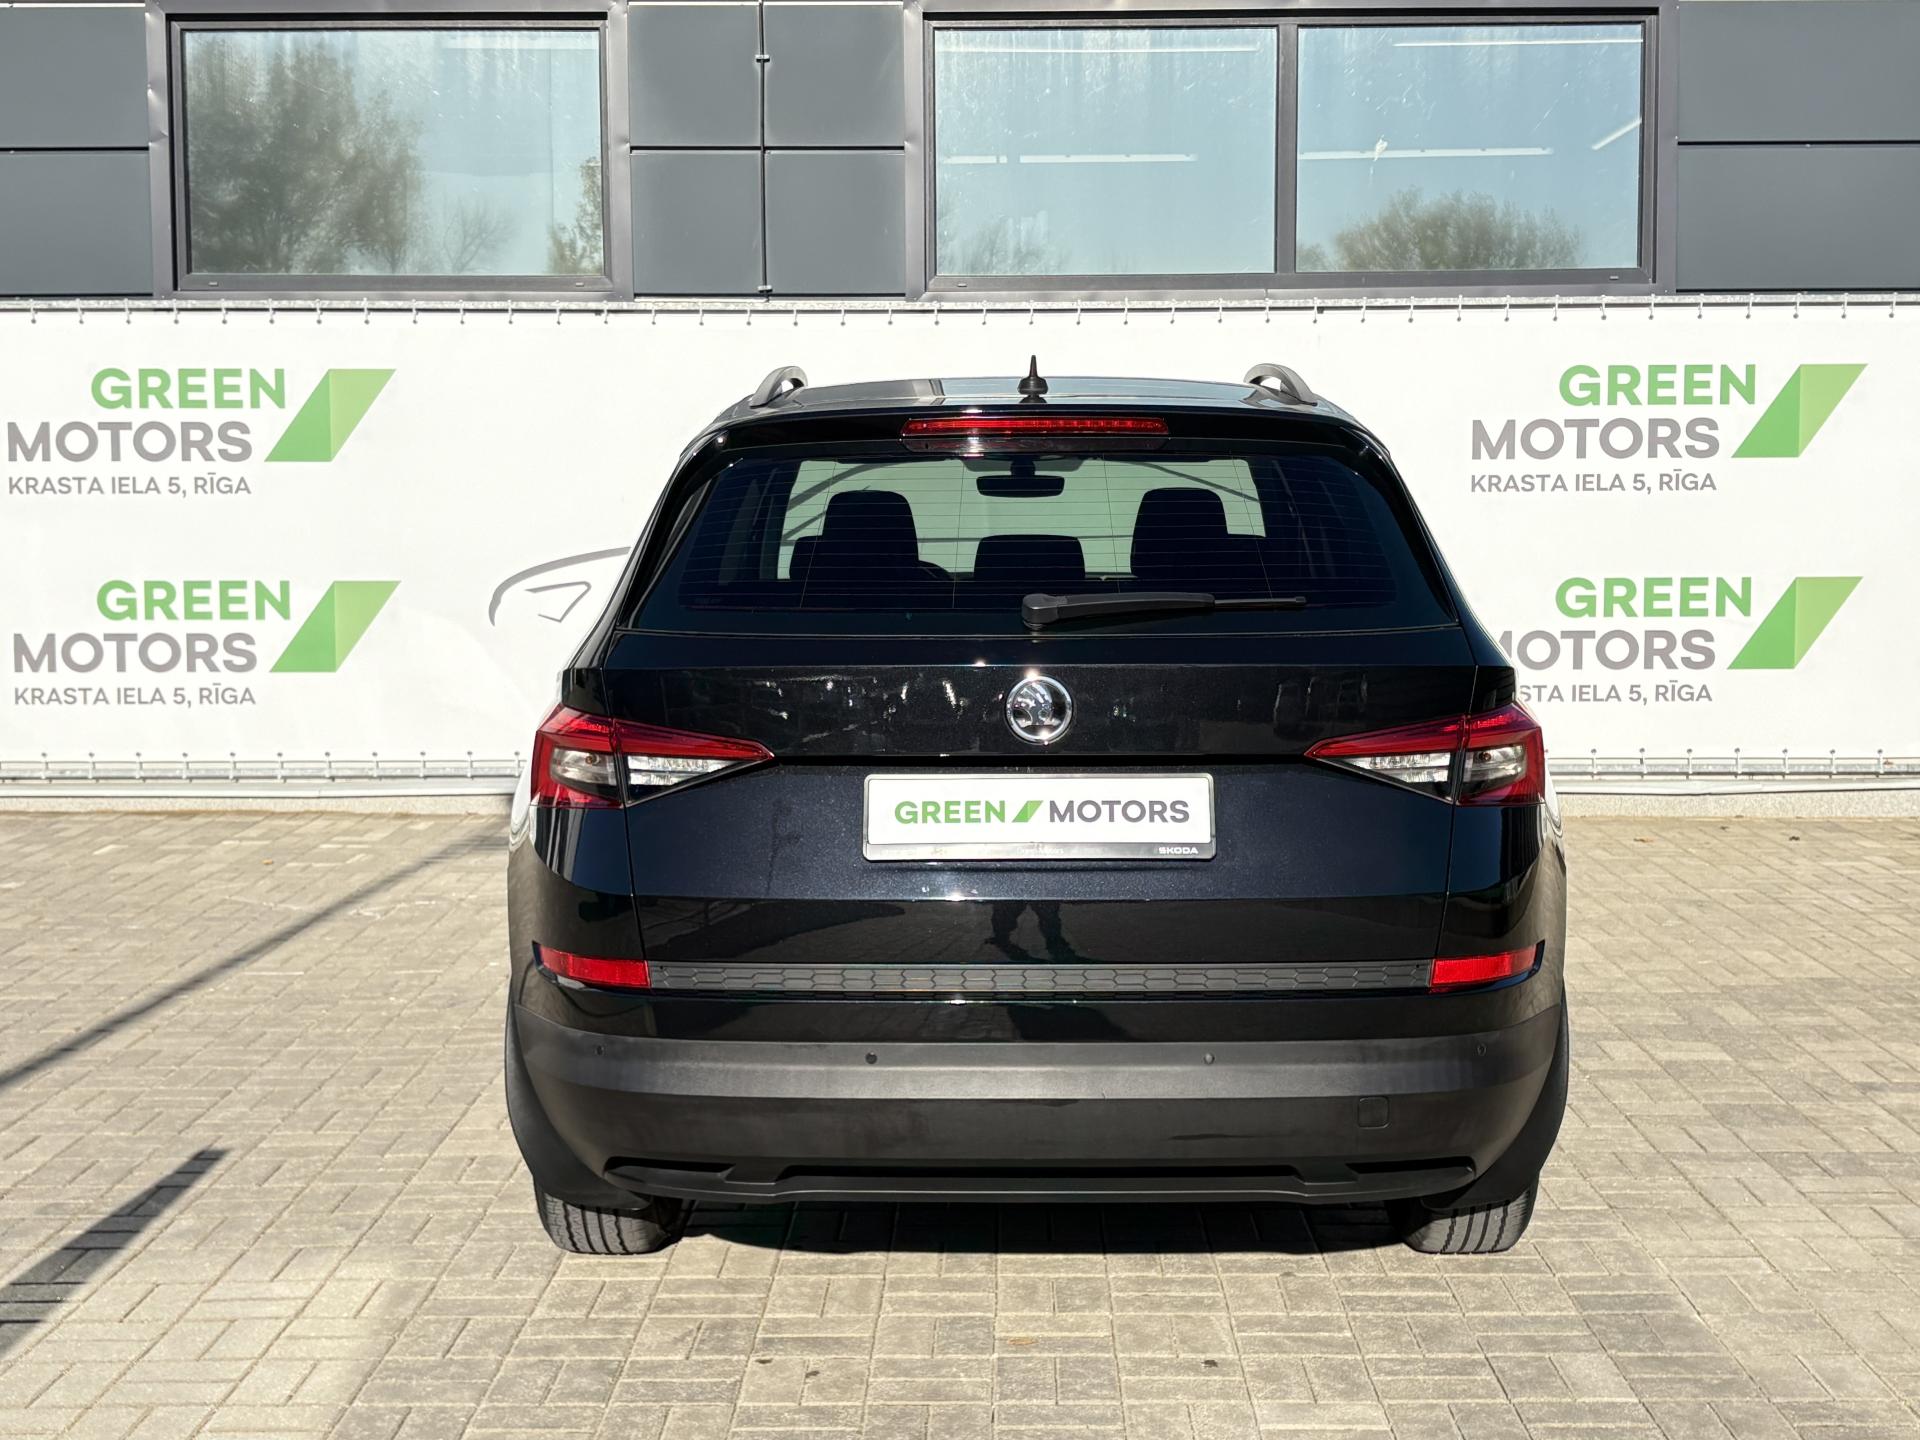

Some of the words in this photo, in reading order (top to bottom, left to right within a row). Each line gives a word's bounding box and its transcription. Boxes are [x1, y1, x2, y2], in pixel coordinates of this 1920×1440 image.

[91, 368, 286, 409] GREEN
[1559, 364, 1756, 406] GREEN
[7, 421, 253, 462] MOTORS
[1472, 417, 1720, 460] MOTORS
[8, 477, 105, 494] KRASTA
[111, 477, 161, 494] IELA
[168, 477, 187, 498] 5,
[194, 473, 252, 494] RĪGA
[1471, 474, 1568, 492] KRASTA
[1575, 474, 1625, 491] IELA
[1632, 474, 1651, 495] 5,
[1659, 469, 1717, 491] RĪGA
[97, 580, 291, 621] GREEN
[1555, 577, 1752, 618] GREEN
[13, 633, 257, 673] MOTORS
[15, 688, 109, 704] KRASTA
[117, 688, 166, 704] IELA
[173, 688, 192, 708] 5,
[199, 683, 256, 704] RĪGA
[1572, 685, 1622, 702] IELA
[1628, 685, 1648, 706] 5,
[1655, 680, 1713, 702] RĪGA
[895, 800, 1006, 824] GREEN
[1049, 800, 1190, 823] MOTORS
